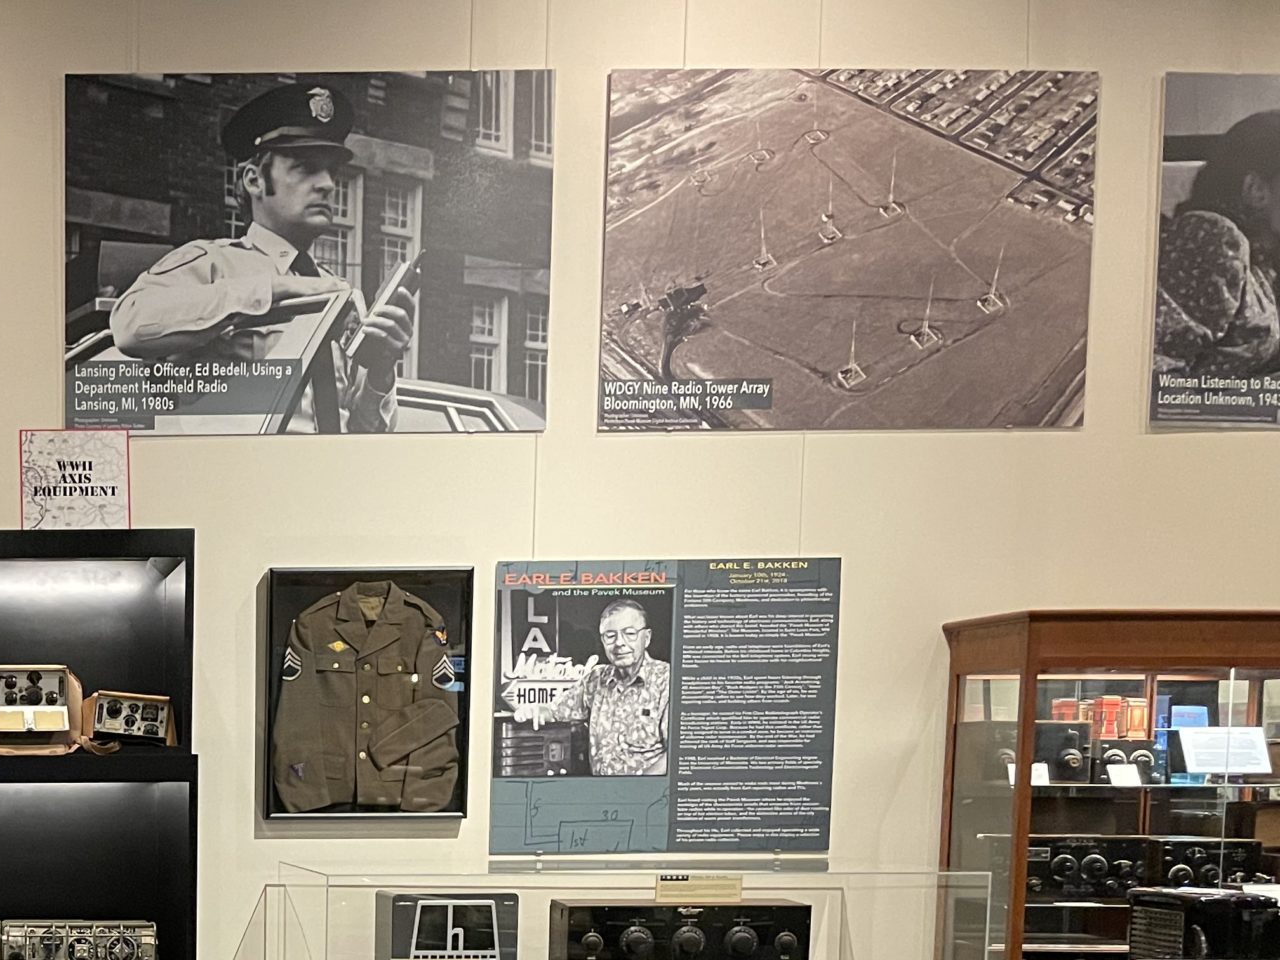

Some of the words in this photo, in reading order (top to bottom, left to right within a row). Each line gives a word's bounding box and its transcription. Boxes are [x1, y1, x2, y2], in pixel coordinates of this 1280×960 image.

[75, 365, 115, 380] Lansing
[119, 365, 150, 376] Police
[154, 365, 193, 378] Officer,
[195, 365, 210, 375] Ed
[212, 364, 249, 378] Bedell,
[252, 364, 282, 379] Using
[286, 367, 292, 375] a
[75, 381, 138, 396] Department
[142, 381, 194, 392] Handheld
[197, 381, 228, 392] Radio
[605, 382, 640, 394] WDGY
[644, 382, 668, 394] Nine
[672, 382, 702, 394] Radio
[706, 381, 738, 394] Tower
[740, 381, 769, 397] Array
[1160, 375, 1198, 388] Woman
[1202, 376, 1247, 392] Listening
[1251, 377, 1260, 389] to
[76, 398, 118, 413] Lansing,
[122, 398, 137, 412] MI,
[142, 397, 173, 409] 1980s
[605, 396, 676, 413] Bloomington,
[680, 396, 701, 411] MN,
[706, 396, 732, 409] 1966
[1159, 391, 1200, 404] Location
[1206, 392, 1255, 407] Unknown,
[56, 461, 93, 471] WWII
[59, 473, 92, 484] AXIS
[33, 486, 118, 496] EQUIPMENT
[504, 573, 556, 585] EARL
[560, 573, 576, 584] E.
[580, 572, 666, 584] BAKKEN
